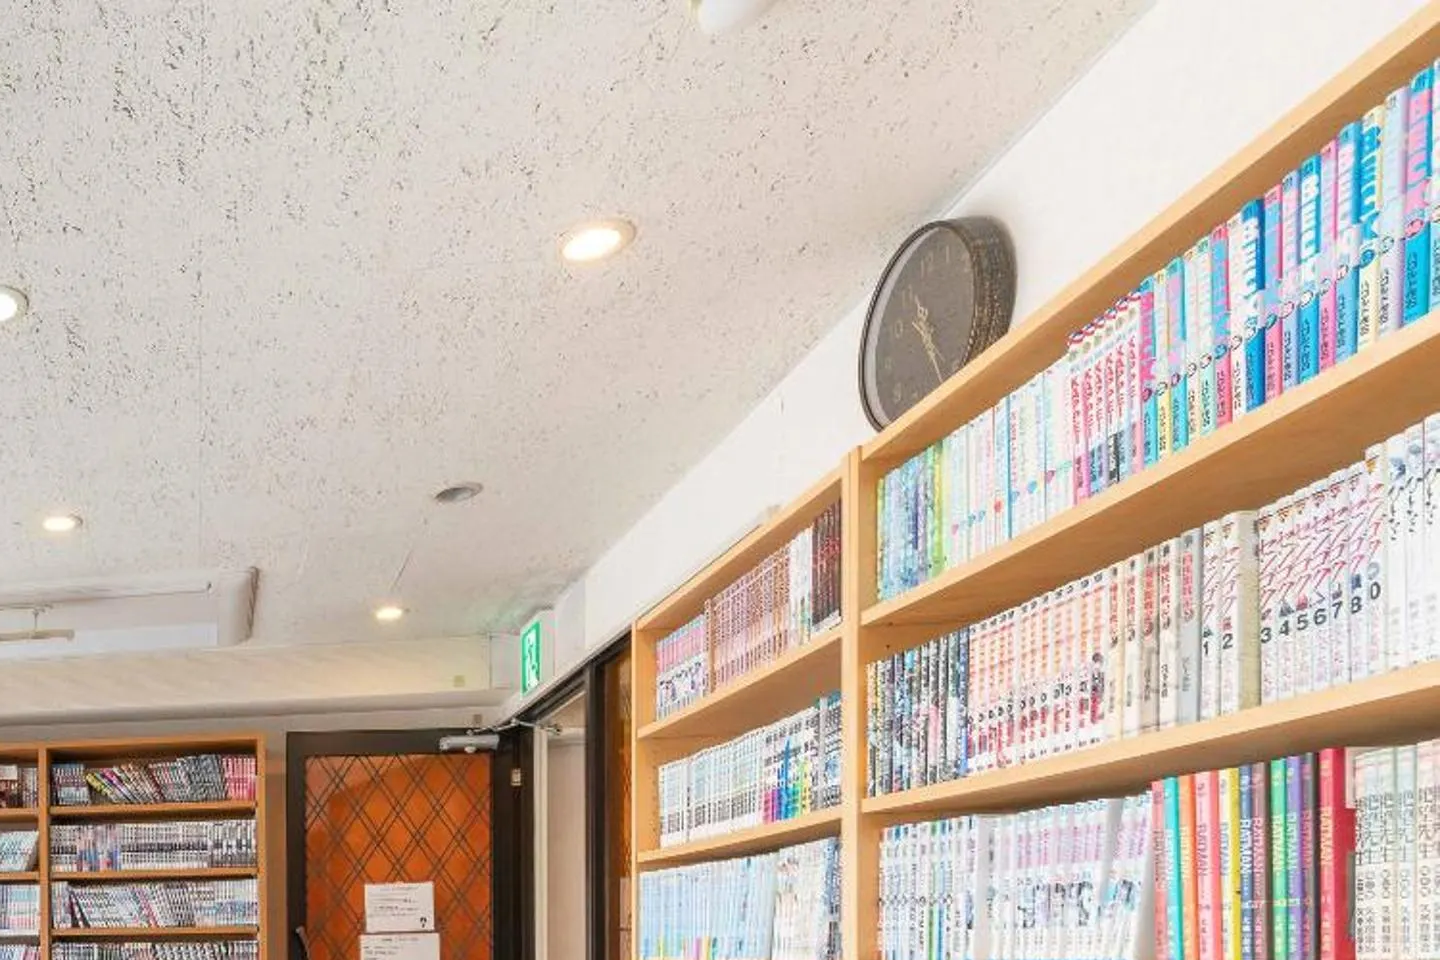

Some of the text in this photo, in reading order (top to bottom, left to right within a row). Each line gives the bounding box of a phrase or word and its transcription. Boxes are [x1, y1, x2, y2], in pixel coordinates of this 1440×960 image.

[1332, 601, 1343, 619] 7
[1351, 596, 1362, 614] 8
[1297, 613, 1309, 631] 5
[1313, 608, 1327, 625] 6
[1260, 627, 1272, 643] 3
[1279, 620, 1290, 636] 4
[1222, 633, 1233, 650] 2
[1240, 819, 1252, 874] RATMAN
